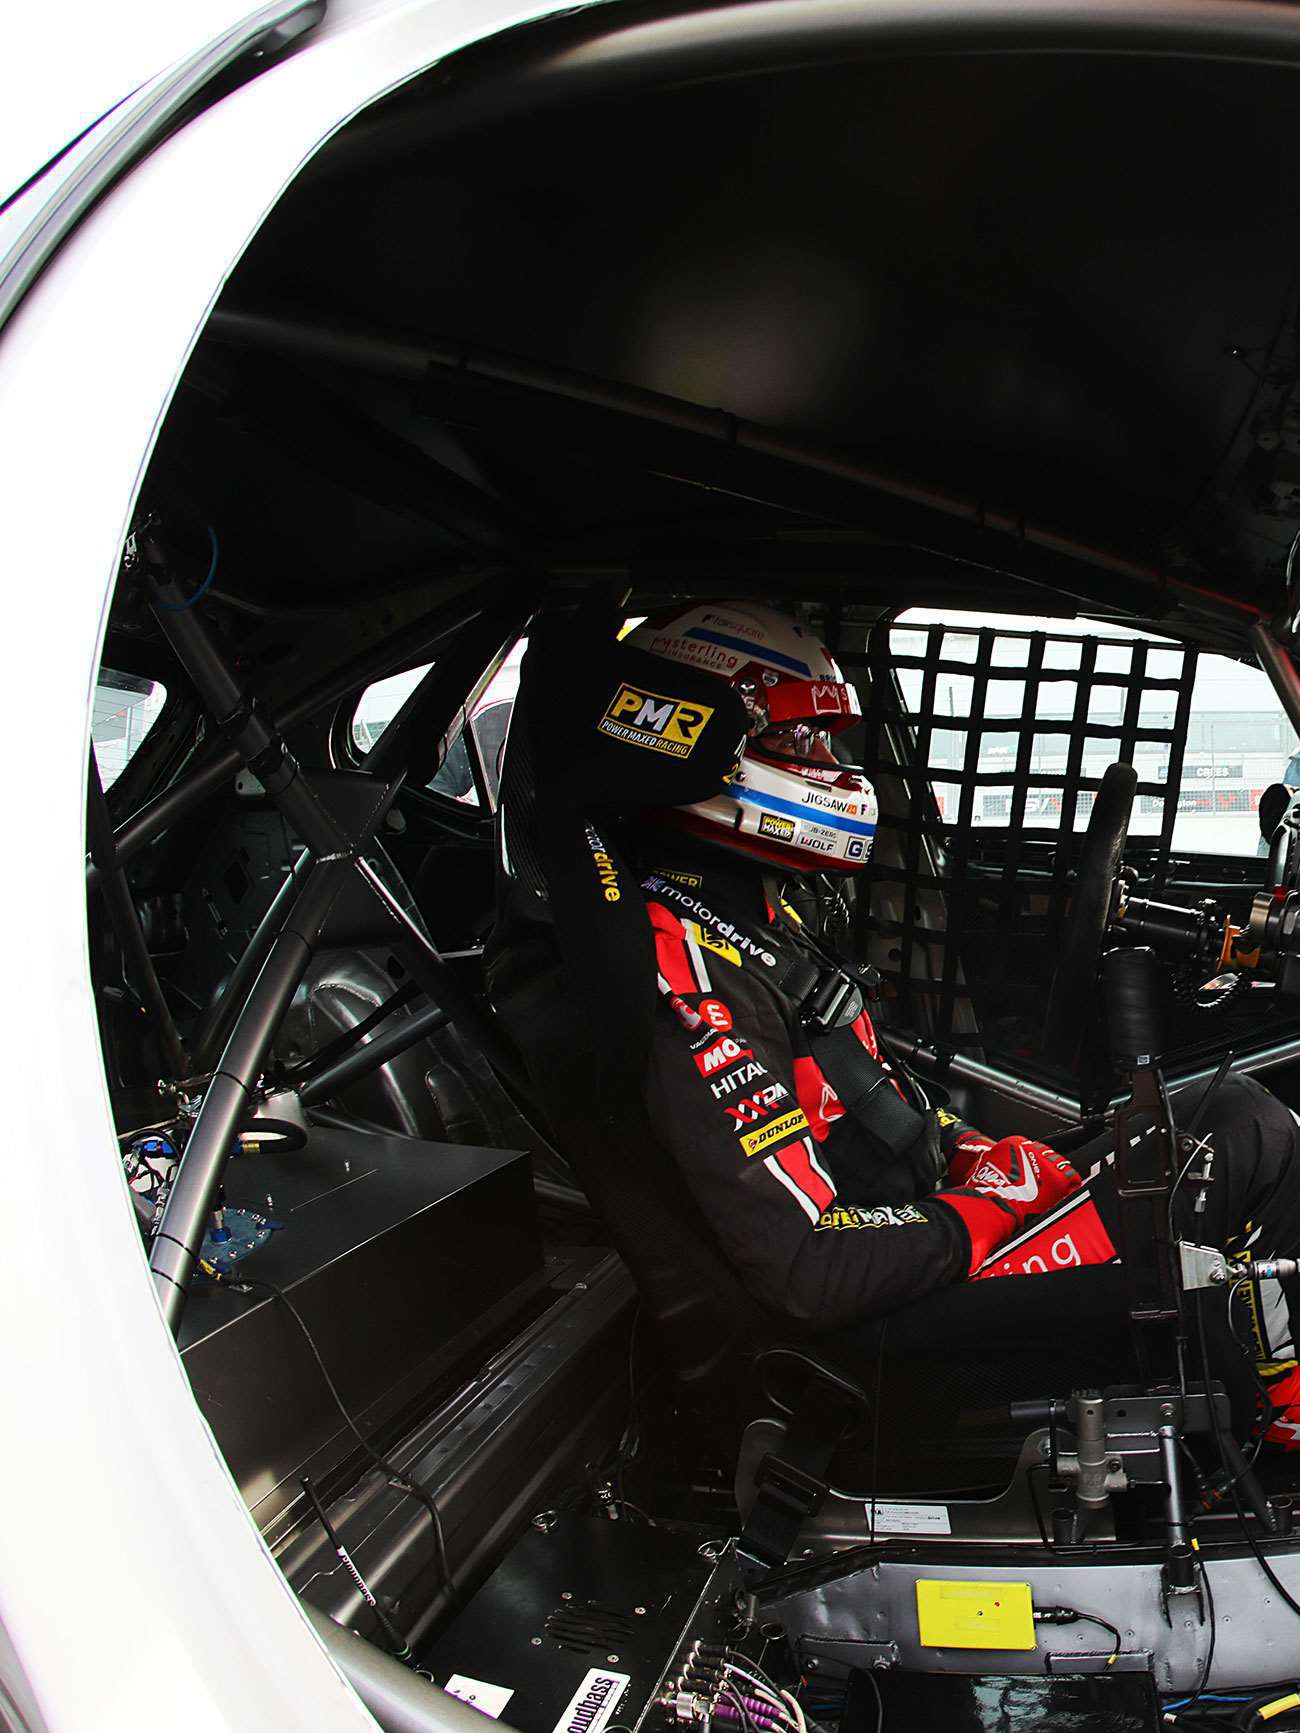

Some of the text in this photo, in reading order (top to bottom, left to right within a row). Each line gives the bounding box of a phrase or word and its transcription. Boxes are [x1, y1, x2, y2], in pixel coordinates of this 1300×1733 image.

[670, 639, 738, 668] sterling
[611, 690, 704, 738] PMR
[602, 721, 688, 755] POWER MAXED RACING
[763, 824, 791, 839] MAXED
[764, 815, 793, 830] POWER
[801, 837, 834, 852] WOLF
[661, 886, 776, 967] motordrive
[704, 1038, 741, 1072] MO
[758, 1114, 804, 1144] DUNLOP
